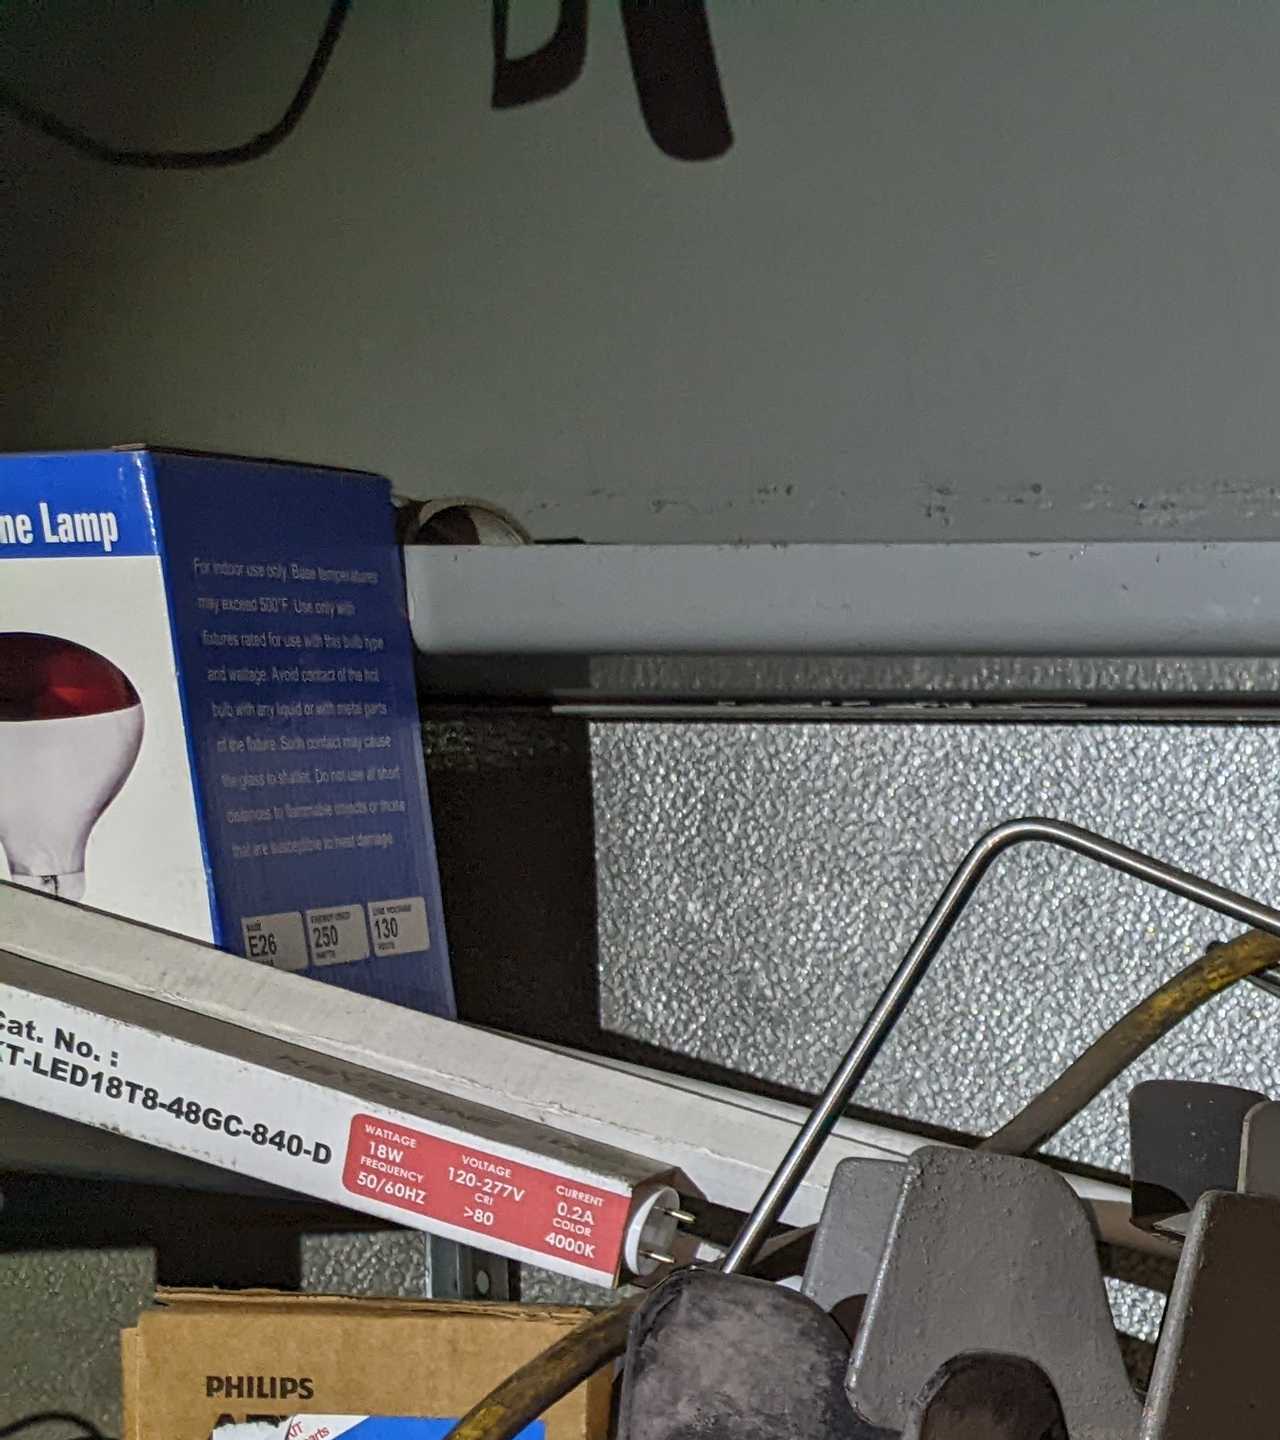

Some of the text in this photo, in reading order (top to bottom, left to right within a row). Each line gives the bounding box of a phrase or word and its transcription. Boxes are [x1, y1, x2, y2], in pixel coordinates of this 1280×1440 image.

[39, 502, 119, 552] Lamp
[312, 924, 339, 949] 250
[374, 917, 399, 940] 130
[249, 932, 278, 958] E26
[54, 1027, 101, 1062] No.
[0, 1041, 333, 1166] T-LED18T8-48GC-840-D
[365, 1124, 417, 1149] WATTAGE
[370, 1141, 404, 1163] 18W
[360, 1155, 424, 1183] FREQUENCY
[462, 1154, 511, 1178] VOLTAGE
[356, 1171, 426, 1205] 50/60HZ
[448, 1166, 526, 1202] 120-277V
[555, 1185, 604, 1207] CURRENT
[474, 1192, 494, 1206] CRI
[463, 1206, 494, 1226] >80
[557, 1201, 595, 1226] 0.2A
[552, 1217, 592, 1237] COLOR
[544, 1232, 596, 1258] 4000K
[205, 1375, 315, 1400] PHILIPS
